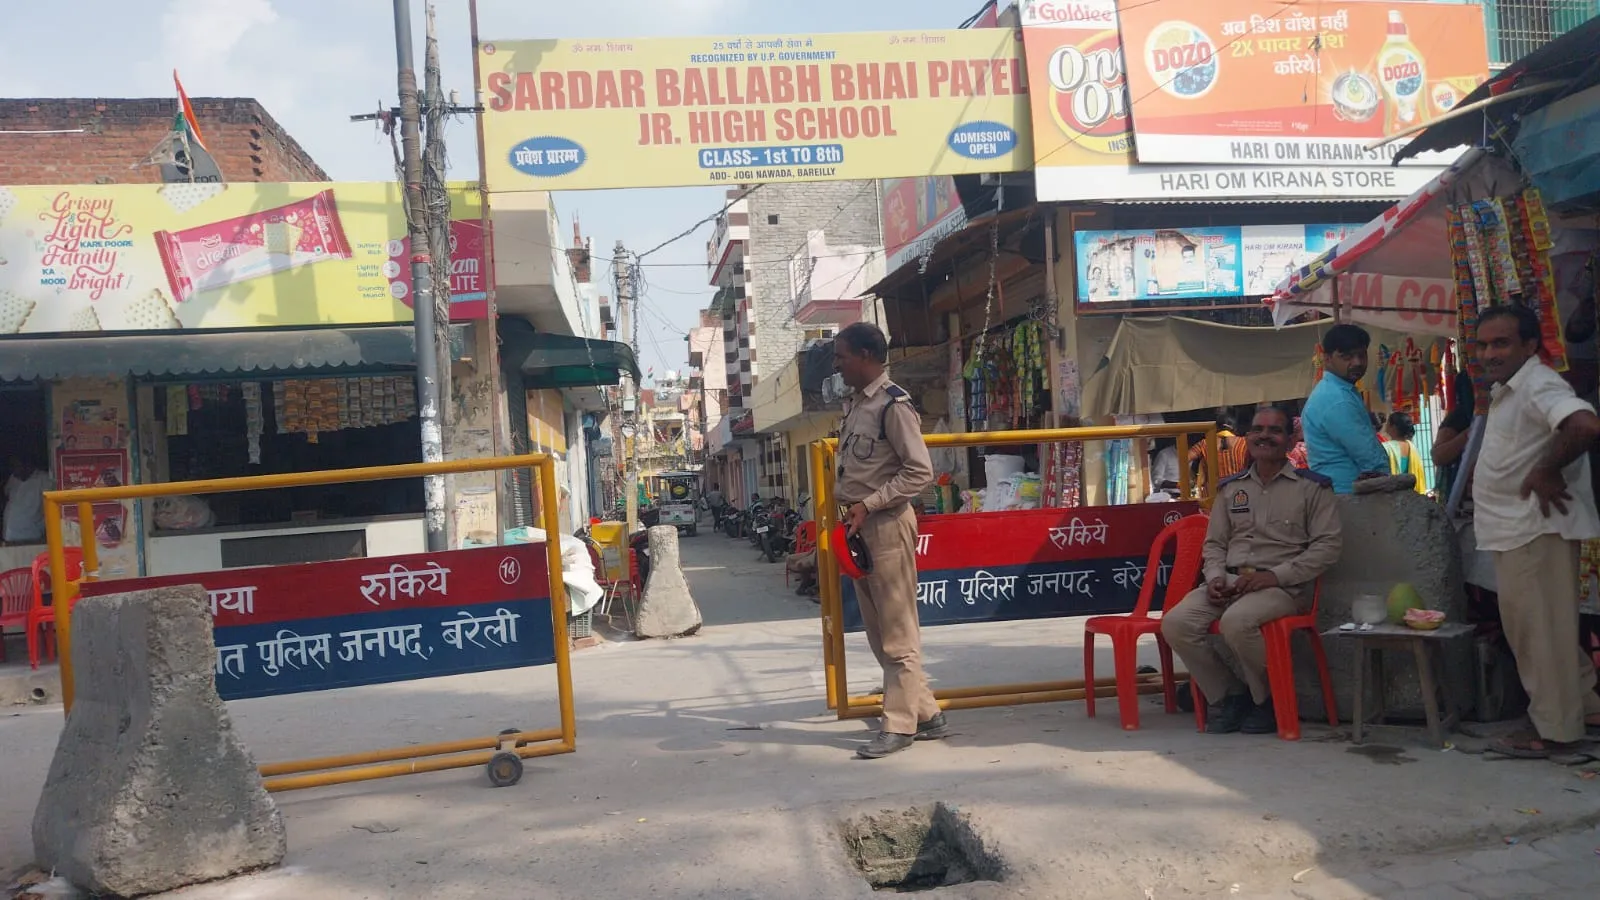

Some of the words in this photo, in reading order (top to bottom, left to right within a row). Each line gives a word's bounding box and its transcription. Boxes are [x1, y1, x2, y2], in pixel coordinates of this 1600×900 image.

[1039, 2, 1112, 22] Goldiee
[1220, 22, 1245, 35] अब
[1250, 14, 1280, 34] डिश
[1285, 12, 1315, 31] वॉश
[1320, 10, 1349, 31] नहीं
[713, 42, 724, 50] 25
[745, 40, 753, 49] से
[757, 38, 782, 49] आपकी
[787, 38, 802, 48] सेवा
[1231, 41, 1254, 57] 2X
[1258, 37, 1301, 53] पावर
[690, 53, 745, 63] RECOGNIZED
[747, 53, 758, 61] BY
[761, 52, 775, 61] U.P.
[778, 51, 836, 61] GOVERNMENT
[1152, 42, 1211, 72] DOZO
[1384, 61, 1420, 81] DOZO
[487, 69, 646, 112] SARDAR
[655, 64, 822, 107] BALLABH
[830, 61, 918, 101] BHAI
[927, 58, 1028, 98] PATEL
[1435, 91, 1452, 103] DOZO
[638, 113, 682, 146] JR.
[688, 110, 766, 144] HIGH
[774, 105, 898, 141] SCHOOL
[953, 131, 1011, 144] ADMISSION
[515, 146, 543, 166] प्रवेश
[702, 150, 759, 167] CLASS-
[764, 149, 787, 164] 1st
[791, 148, 811, 163] TO
[816, 146, 841, 162] 8th
[969, 143, 997, 155] OPEN
[1230, 142, 1270, 159] HARI
[1274, 142, 1301, 159] OM
[1306, 143, 1364, 160] KIRANA
[710, 172, 731, 180] ADD-
[733, 171, 753, 180] JOGI
[756, 169, 795, 179] NAWADA,
[797, 168, 836, 177] BAREILLY
[1160, 173, 1210, 191] HARI
[1215, 172, 1247, 190] OM
[1253, 171, 1328, 188] KIRANA
[1332, 171, 1396, 188] STORE
[52, 191, 114, 222] Crispy
[39, 211, 133, 252] Light
[41, 245, 117, 278] Family
[67, 272, 124, 300] bright
[1048, 517, 1109, 550] रुकिये
[501, 561, 516, 579] 14
[360, 561, 451, 606] रुकिये
[958, 570, 1018, 605] पुलिस
[256, 630, 332, 677] पुलिस
[440, 608, 521, 650] बरेली
